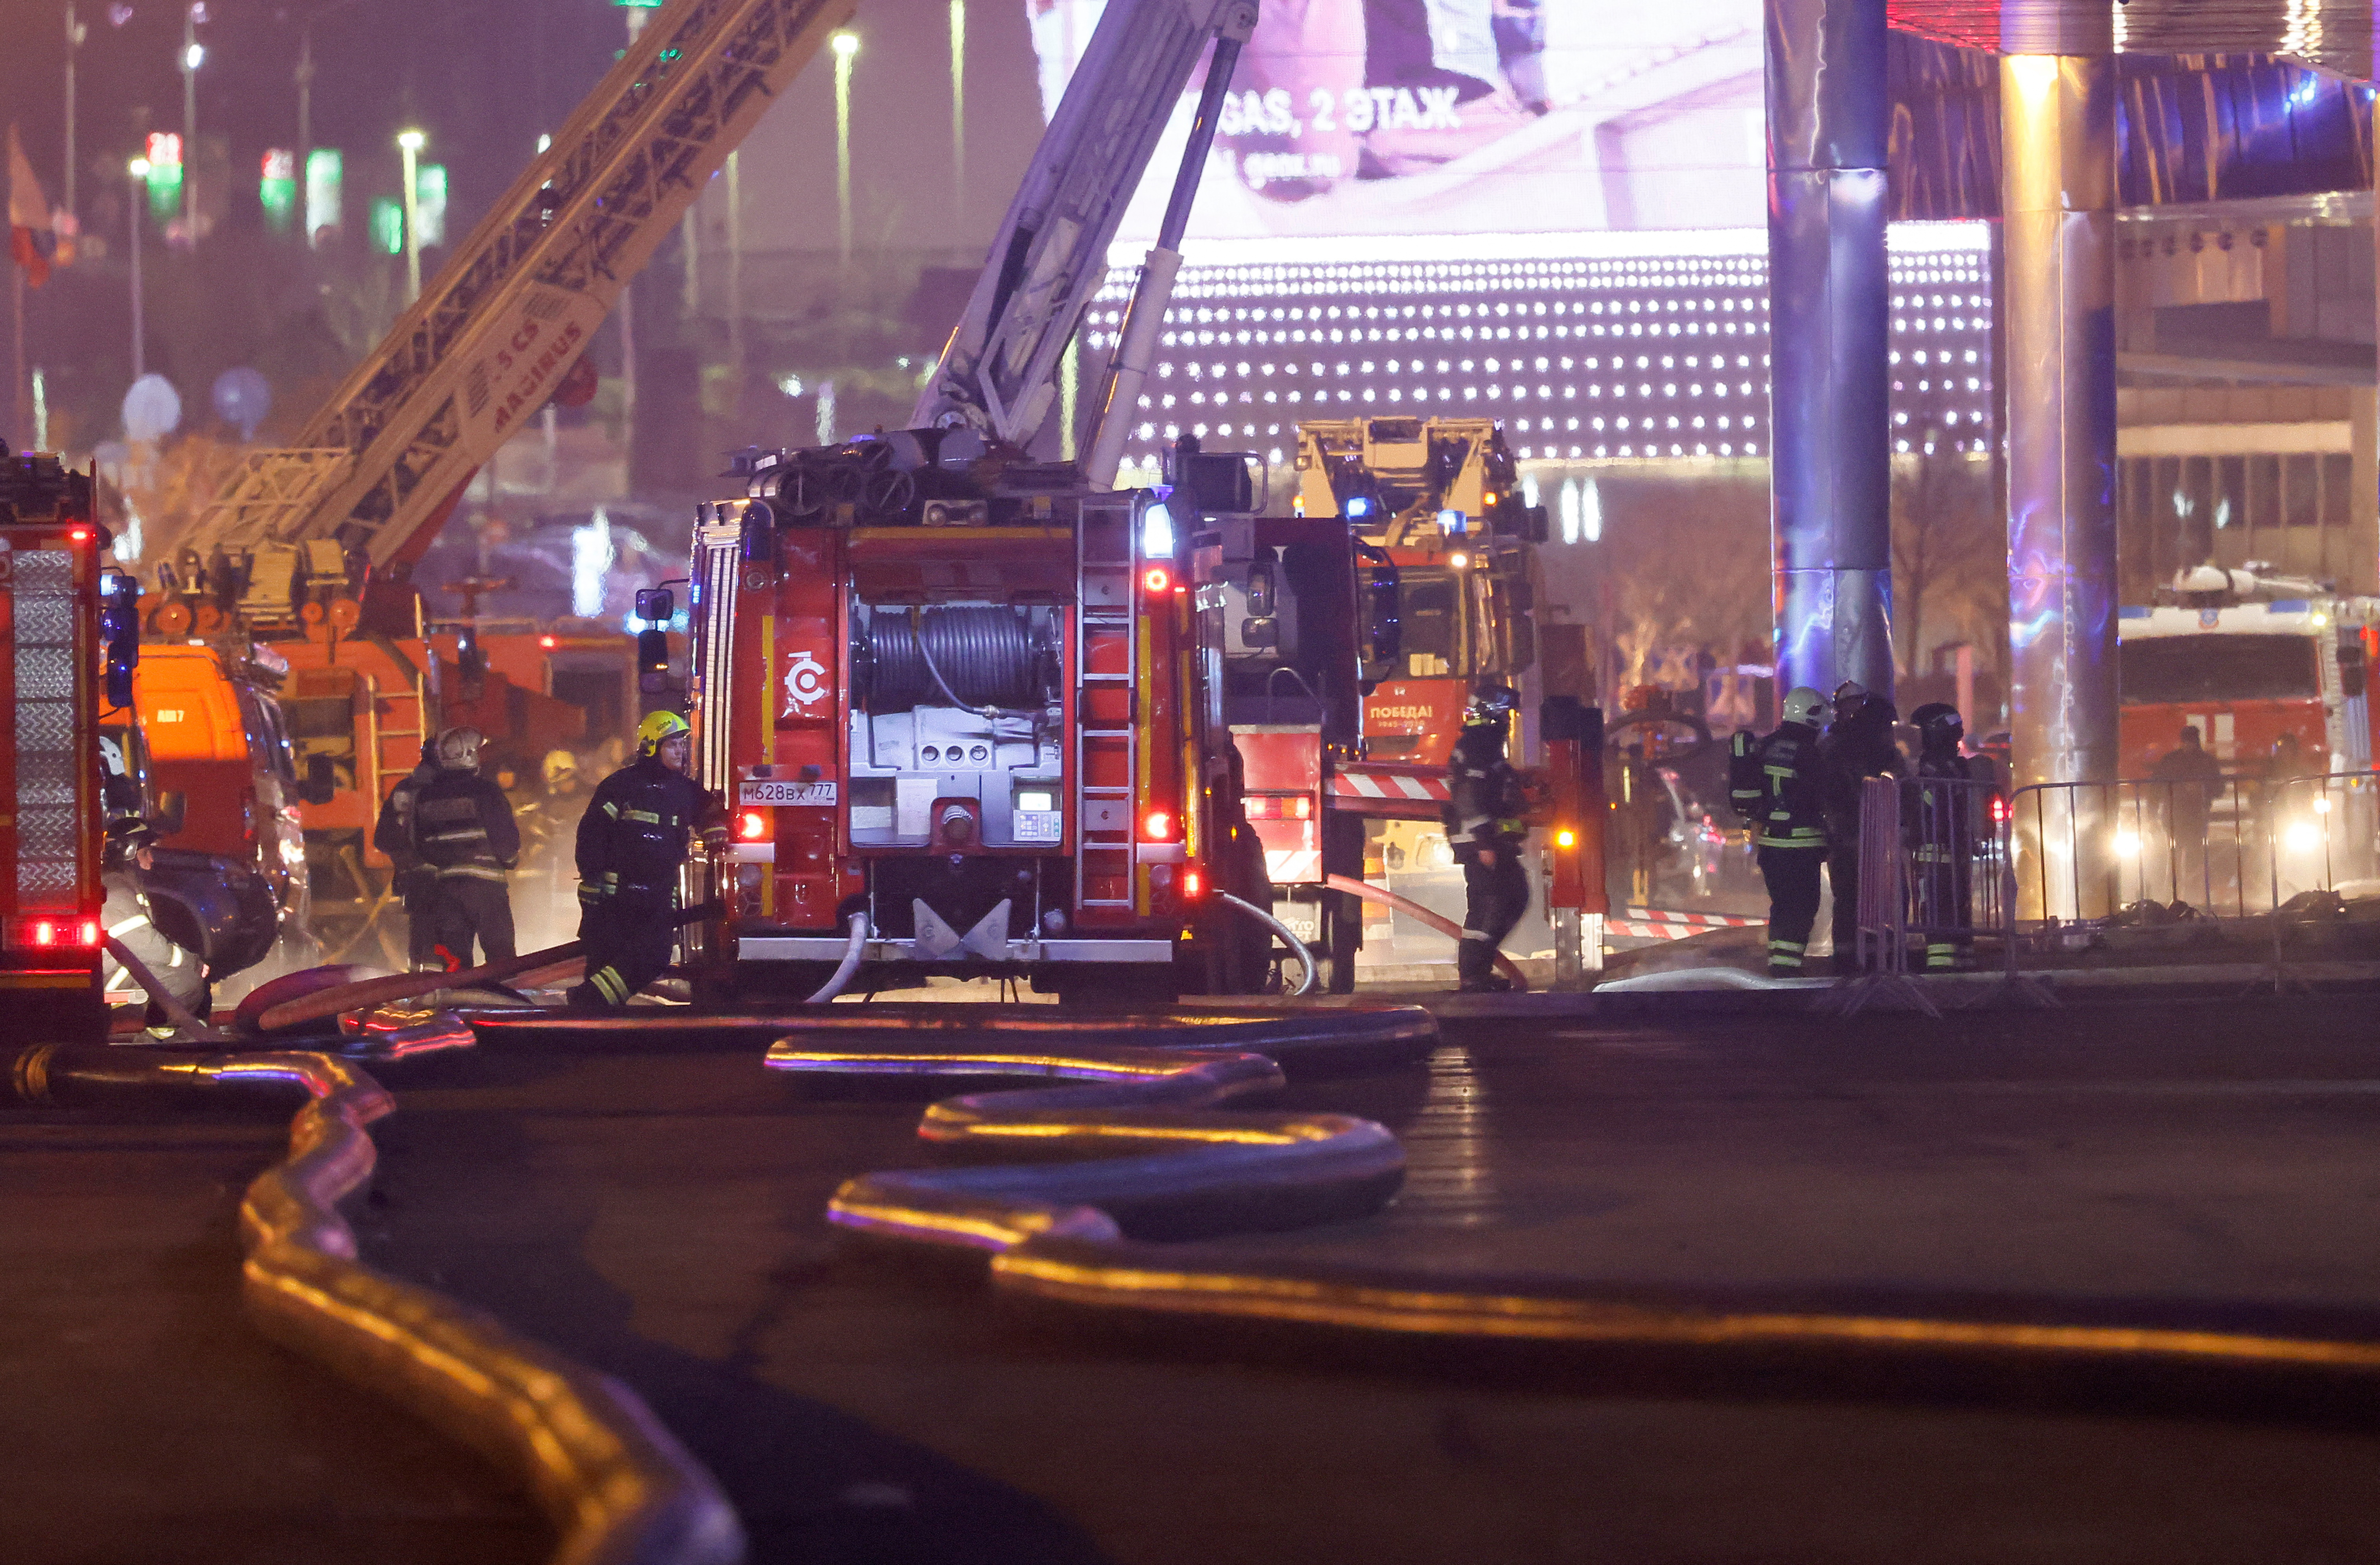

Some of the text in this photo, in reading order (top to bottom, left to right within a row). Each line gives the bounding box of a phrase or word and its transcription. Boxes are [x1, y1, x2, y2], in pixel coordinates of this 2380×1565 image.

[1311, 87, 1336, 132] 2
[1344, 87, 1463, 131] ЭТАЖ
[1370, 705, 1433, 719] ПОБЕДА!
[809, 784, 832, 796] 777
